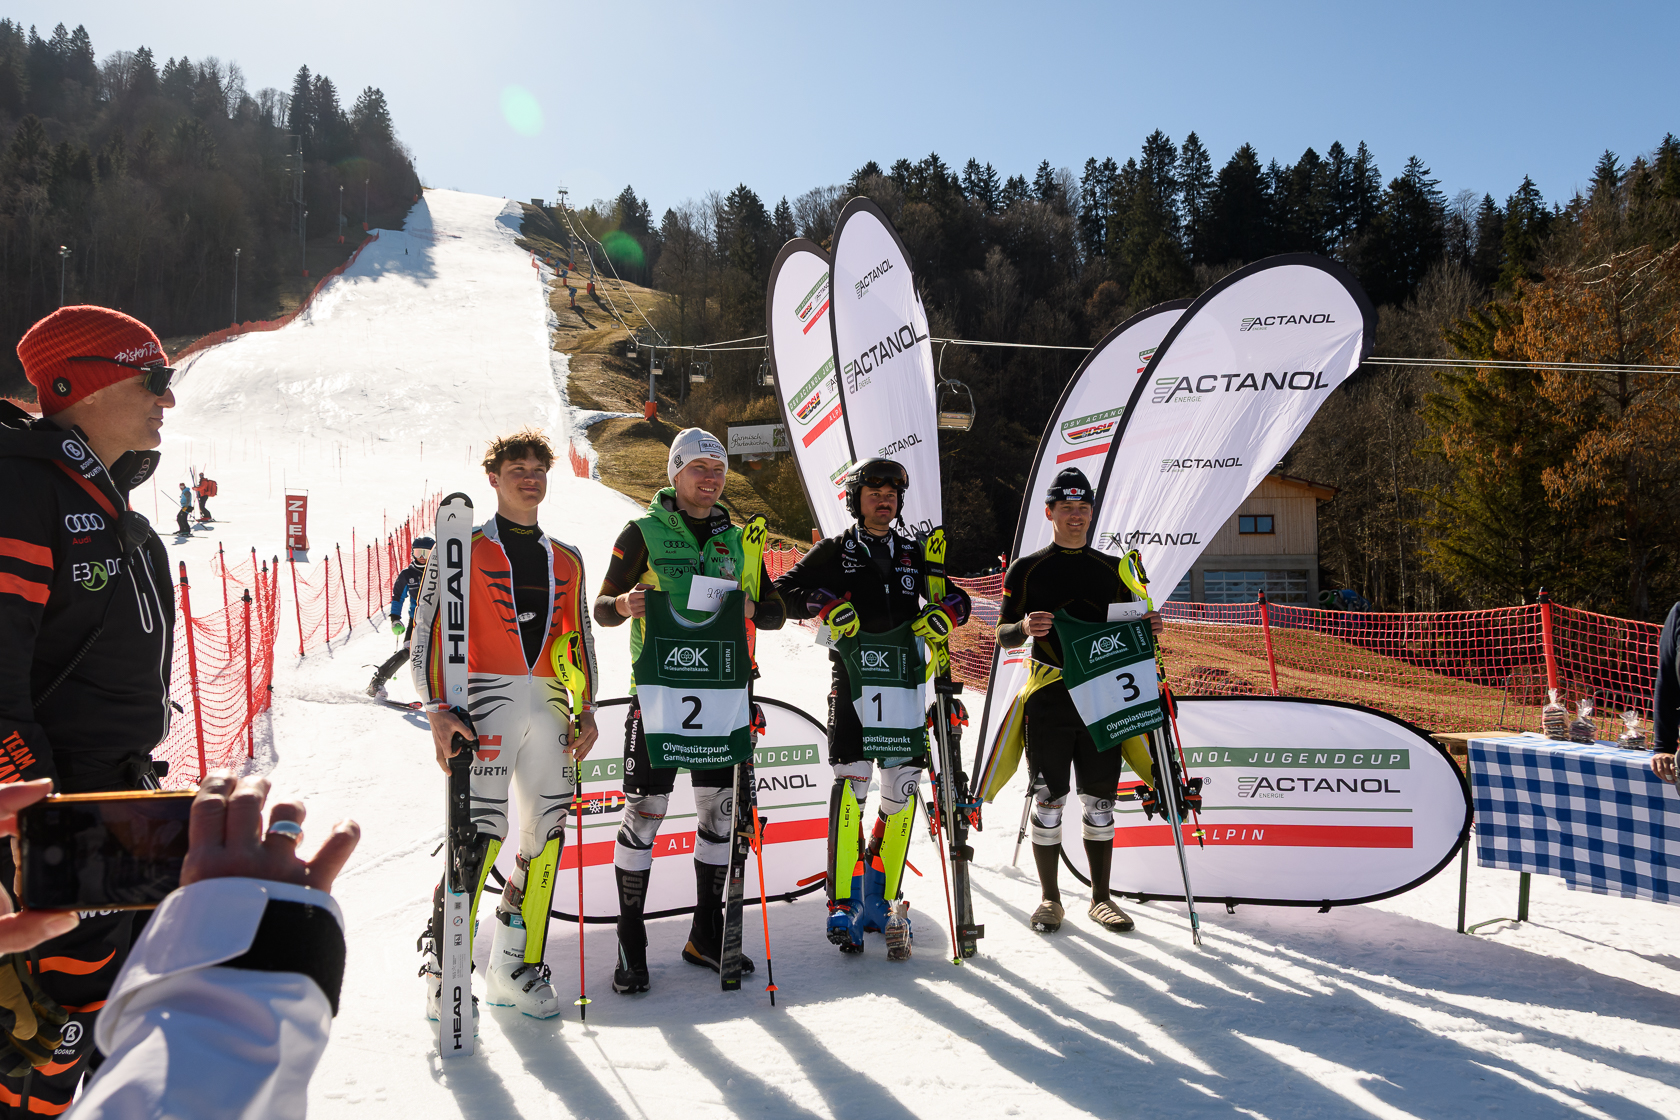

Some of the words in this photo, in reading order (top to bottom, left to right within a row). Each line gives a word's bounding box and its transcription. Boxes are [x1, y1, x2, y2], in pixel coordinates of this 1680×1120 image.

[859, 258, 893, 298] ACTANOL
[1247, 314, 1335, 331] ACTANOL
[853, 321, 928, 392] ACTANOL
[1164, 371, 1329, 403] ACTANOL
[1064, 419, 1081, 429] DSV
[1086, 408, 1124, 423] ACTANO
[731, 433, 762, 444] Garmisch
[884, 433, 923, 459] ACTANOL
[1167, 457, 1243, 473] ACTANOL
[1062, 488, 1086, 496] WOLF
[288, 500, 304, 548] ZIEL
[72, 536, 92, 545] Audi
[422, 562, 438, 606] Audi
[446, 538, 465, 664] HEAD
[1089, 632, 1127, 659] AOK
[1135, 626, 1147, 646] BAYERN
[557, 654, 570, 682] LEKI
[664, 647, 709, 667] AOK
[1115, 672, 1141, 703] 3
[681, 695, 703, 730] 2
[871, 692, 883, 722] 1
[2, 730, 36, 770] TEAM
[754, 749, 813, 764] NDCUP
[1249, 752, 1401, 765] JUGENDCUP
[756, 774, 817, 792] ANOL
[1250, 777, 1401, 798] ACTANOL
[900, 817, 909, 837] LEKI
[540, 863, 551, 889] LEKI
[453, 985, 463, 1050] HEAD
